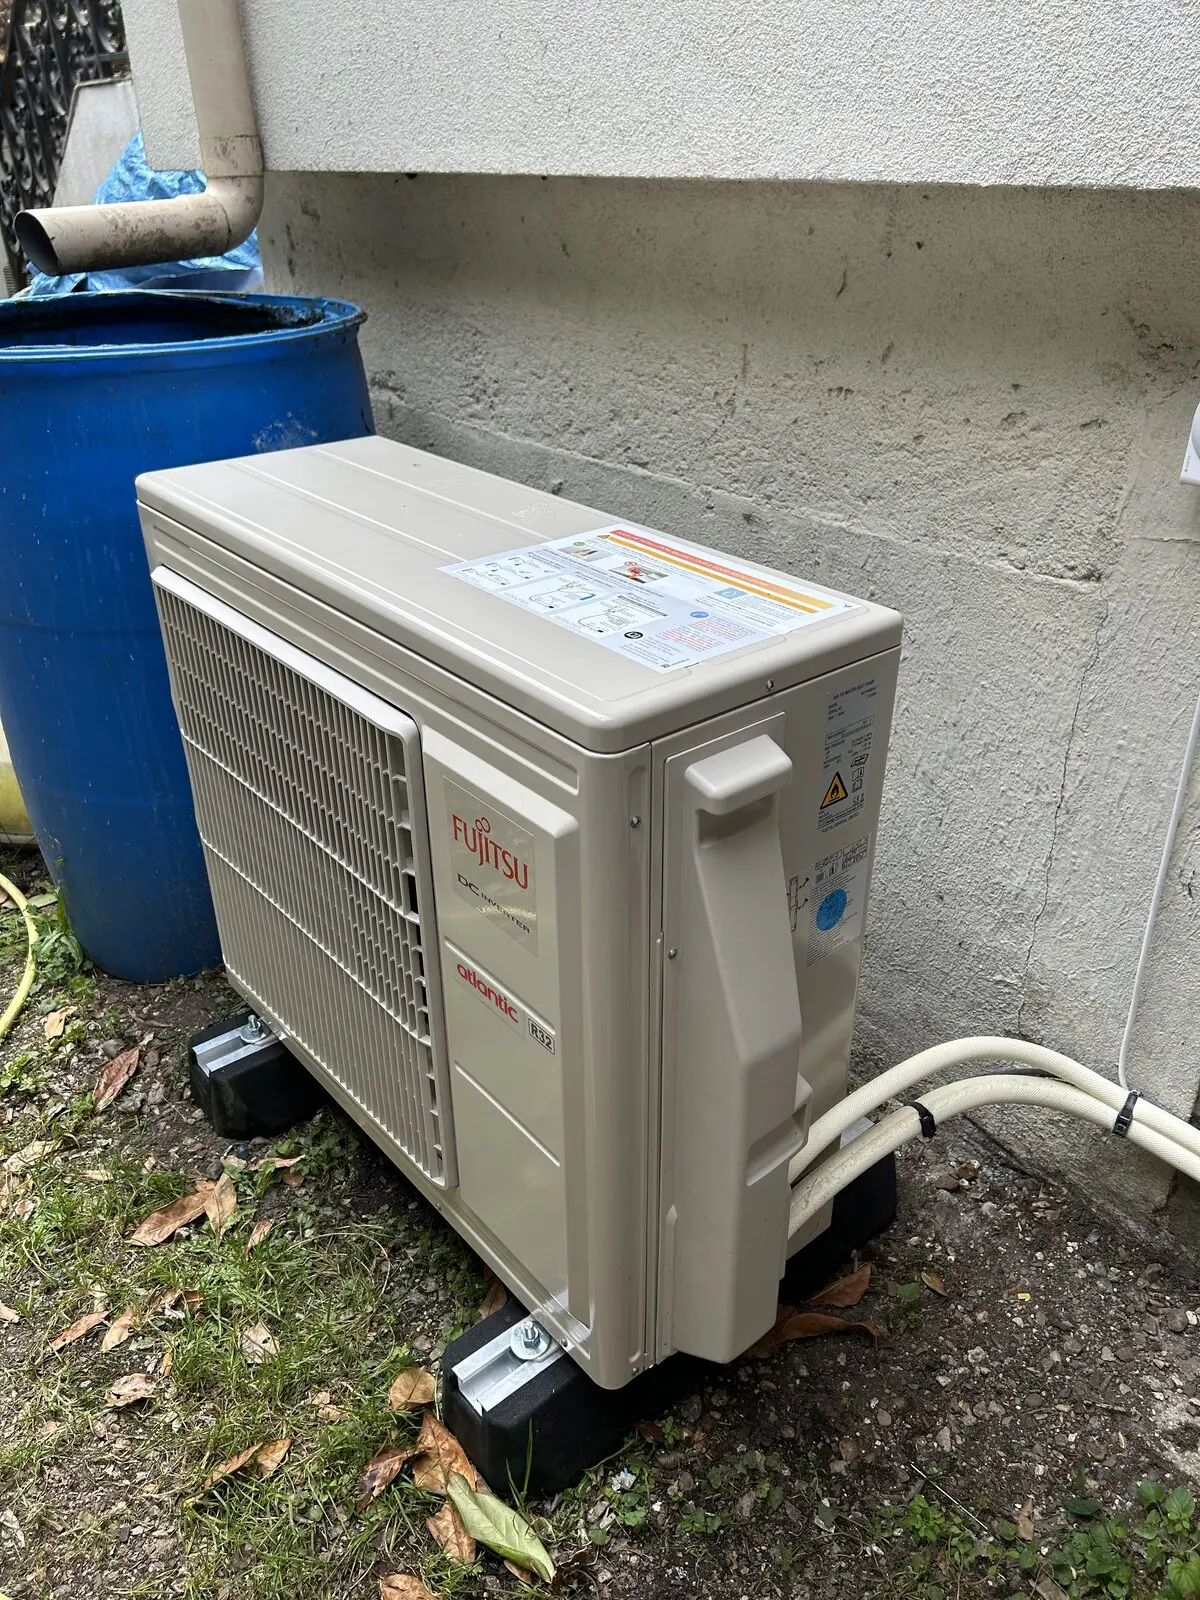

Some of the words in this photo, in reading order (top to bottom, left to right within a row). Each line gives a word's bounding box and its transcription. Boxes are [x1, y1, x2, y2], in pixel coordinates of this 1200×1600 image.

[452, 814, 528, 889] FUJITSU
[457, 872, 480, 896] DC
[481, 892, 530, 934] INVERTER
[456, 963, 518, 1024] atlantic
[530, 1023, 553, 1051] R32
